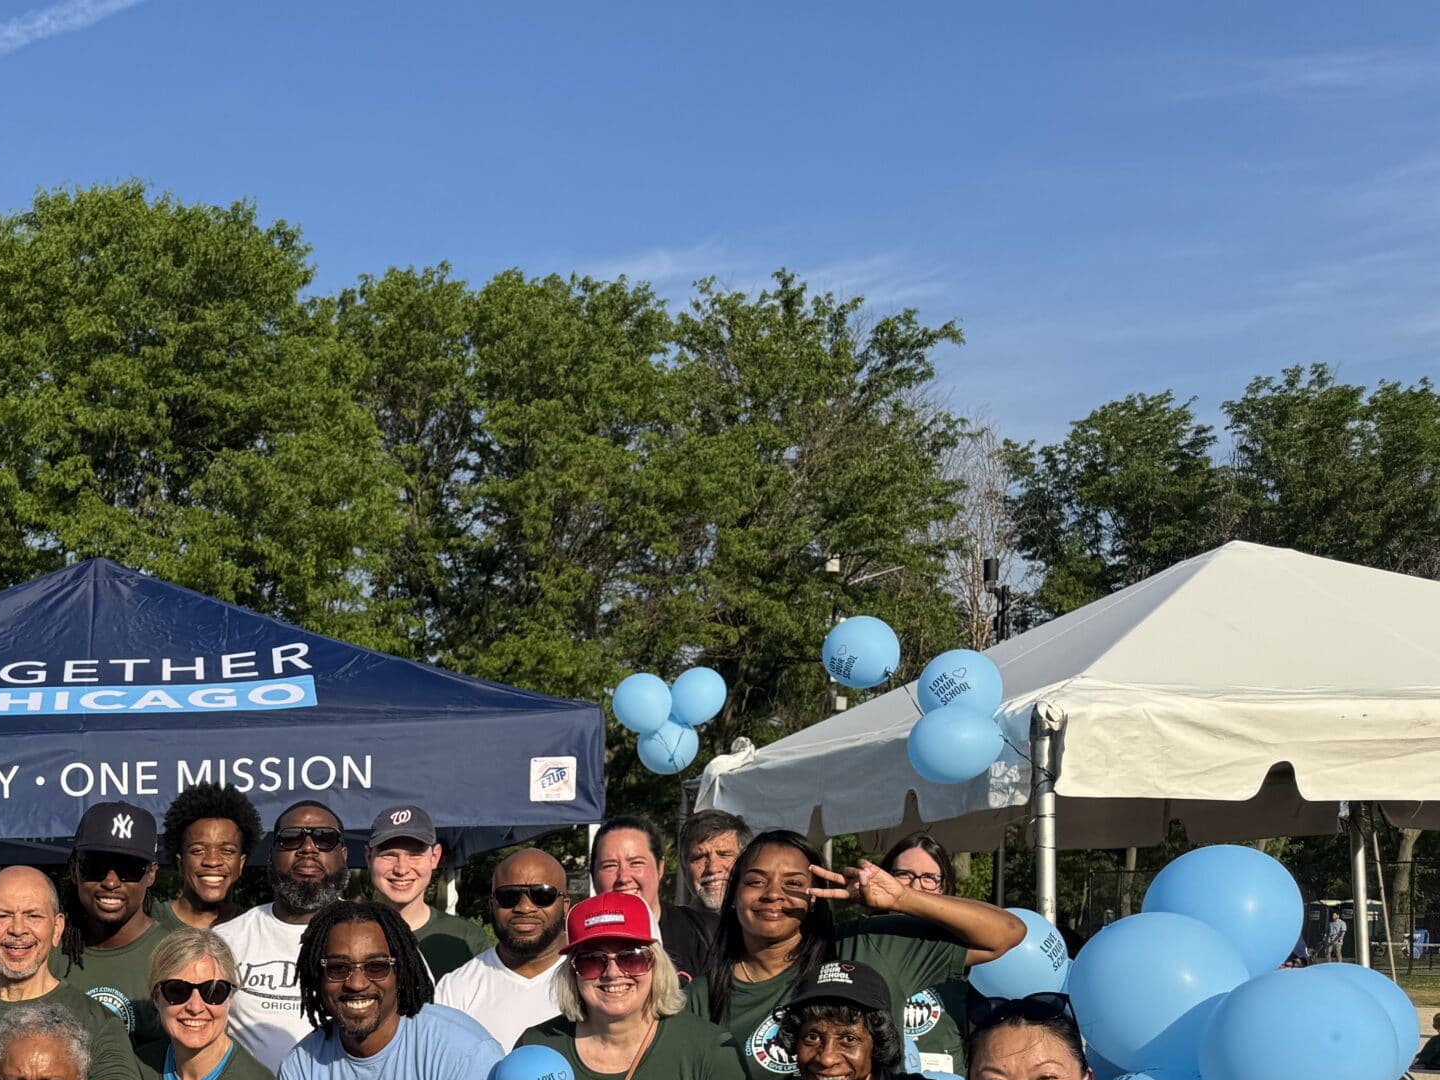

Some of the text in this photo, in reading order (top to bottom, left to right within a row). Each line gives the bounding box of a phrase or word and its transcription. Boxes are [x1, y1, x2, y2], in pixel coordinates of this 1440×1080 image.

[843, 655, 858, 679] SCHOOL
[929, 672, 949, 692] LOVE
[934, 677, 957, 698] YOUR
[940, 681, 972, 706] SCHOOL
[60, 761, 159, 797] ONE
[176, 755, 372, 793] MISSION
[236, 962, 277, 990] Von
